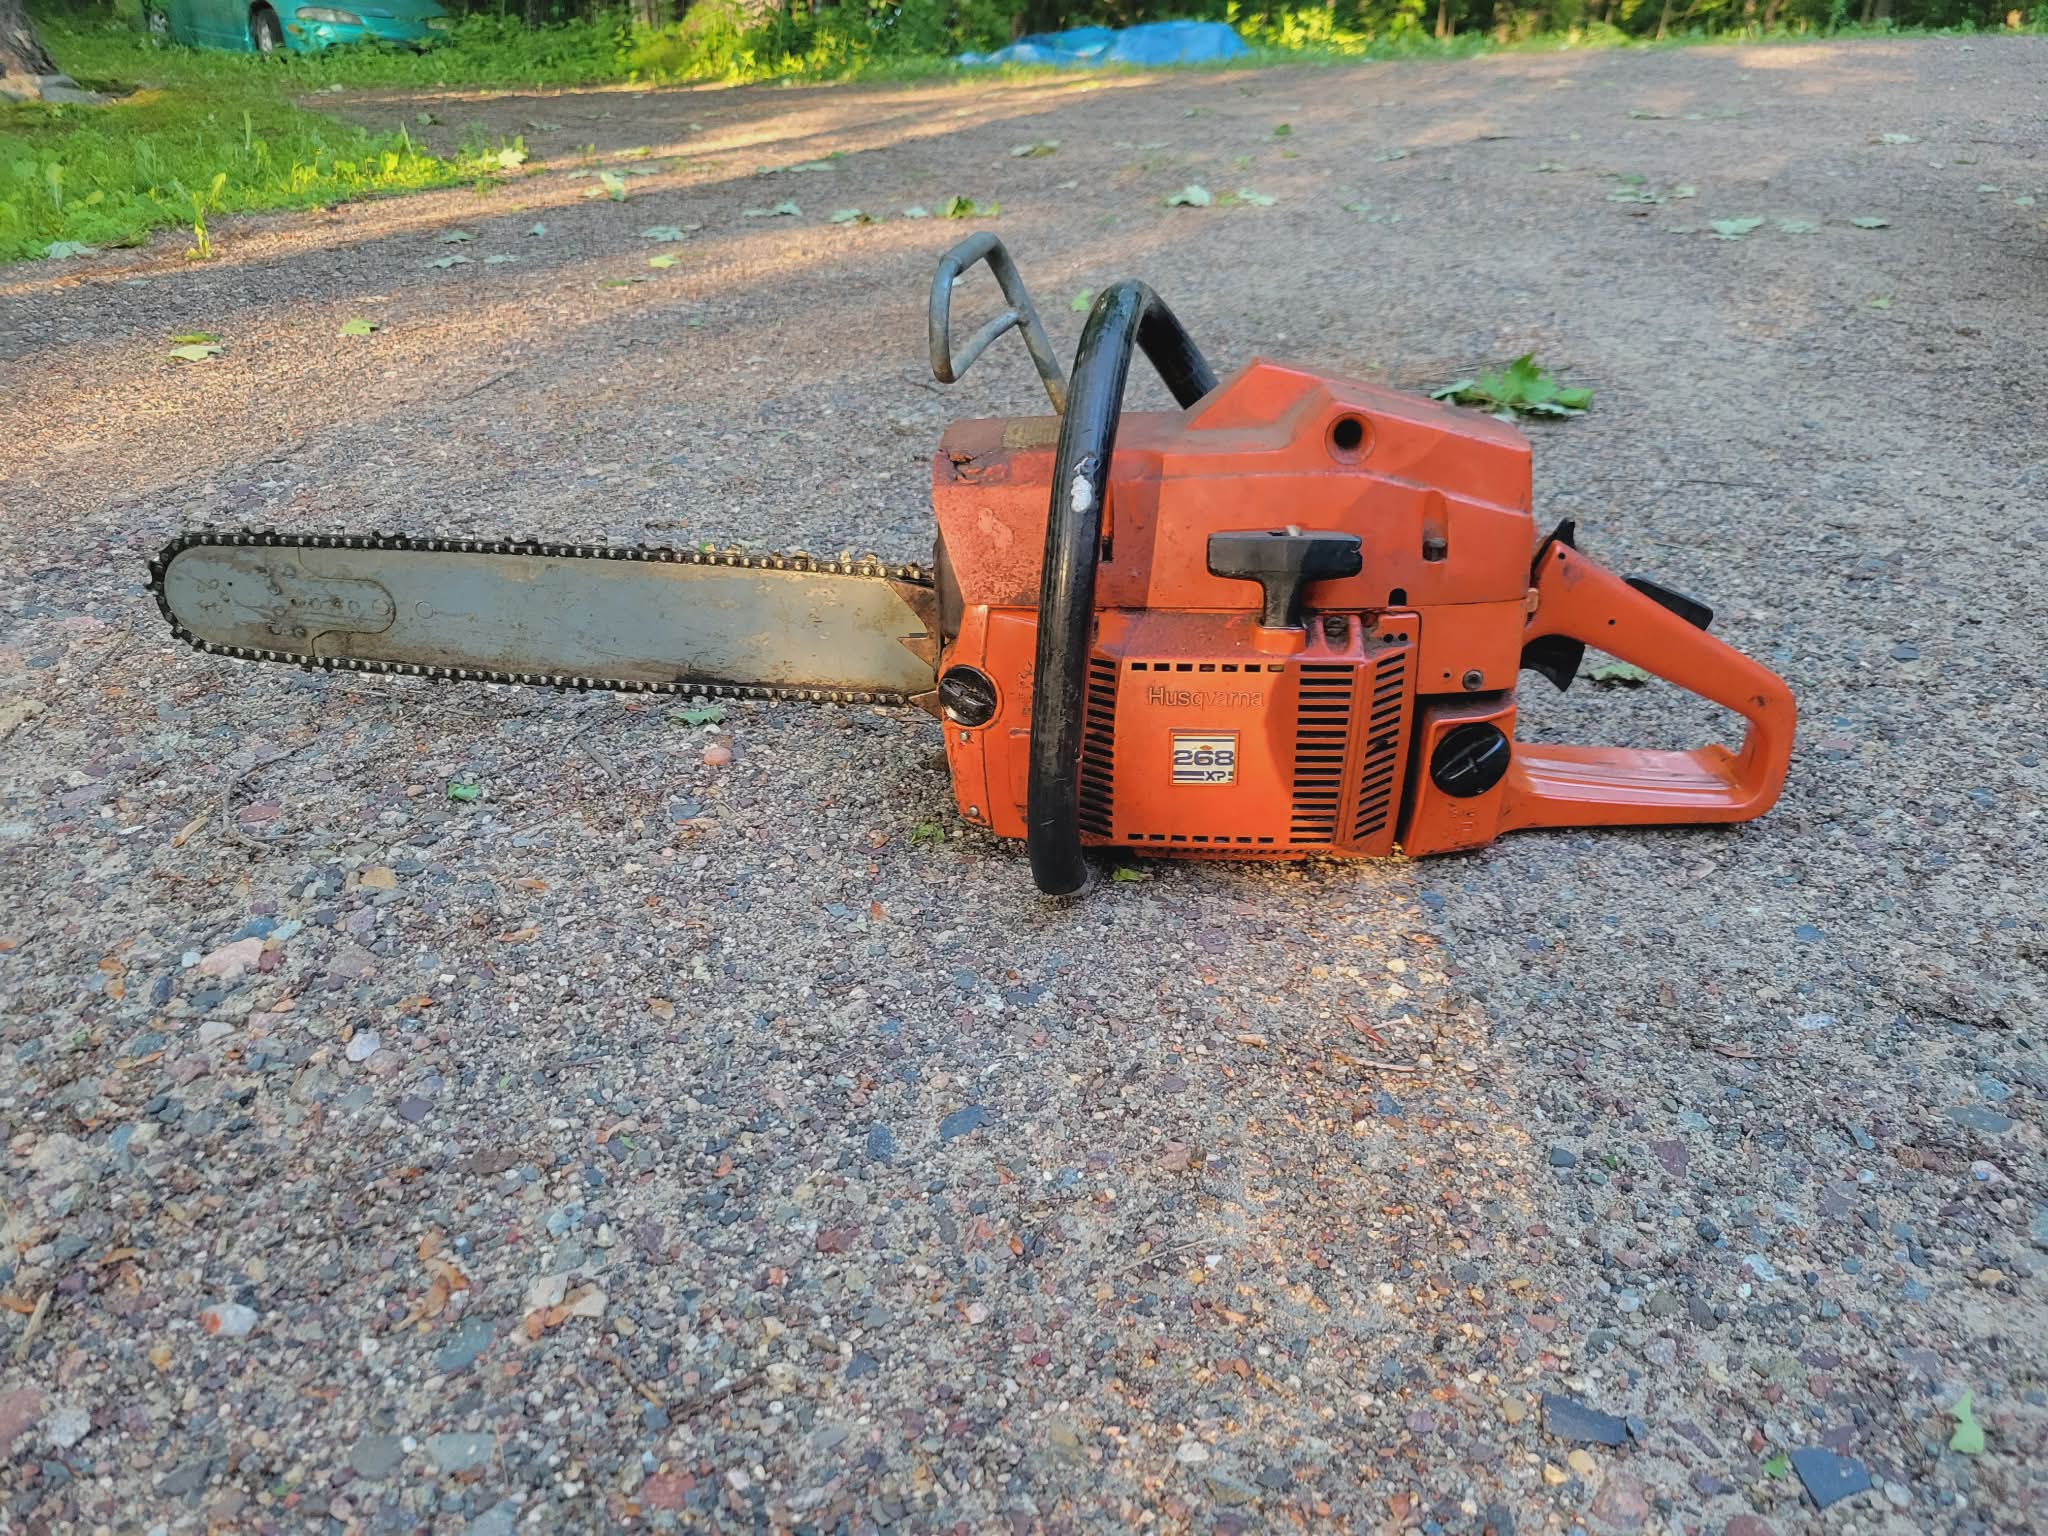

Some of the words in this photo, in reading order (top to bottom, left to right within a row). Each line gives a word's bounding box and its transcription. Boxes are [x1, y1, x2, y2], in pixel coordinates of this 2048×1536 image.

[1148, 687, 1264, 711] Husqvarna
[1174, 750, 1234, 766] 268
[1205, 771, 1226, 781] XP
